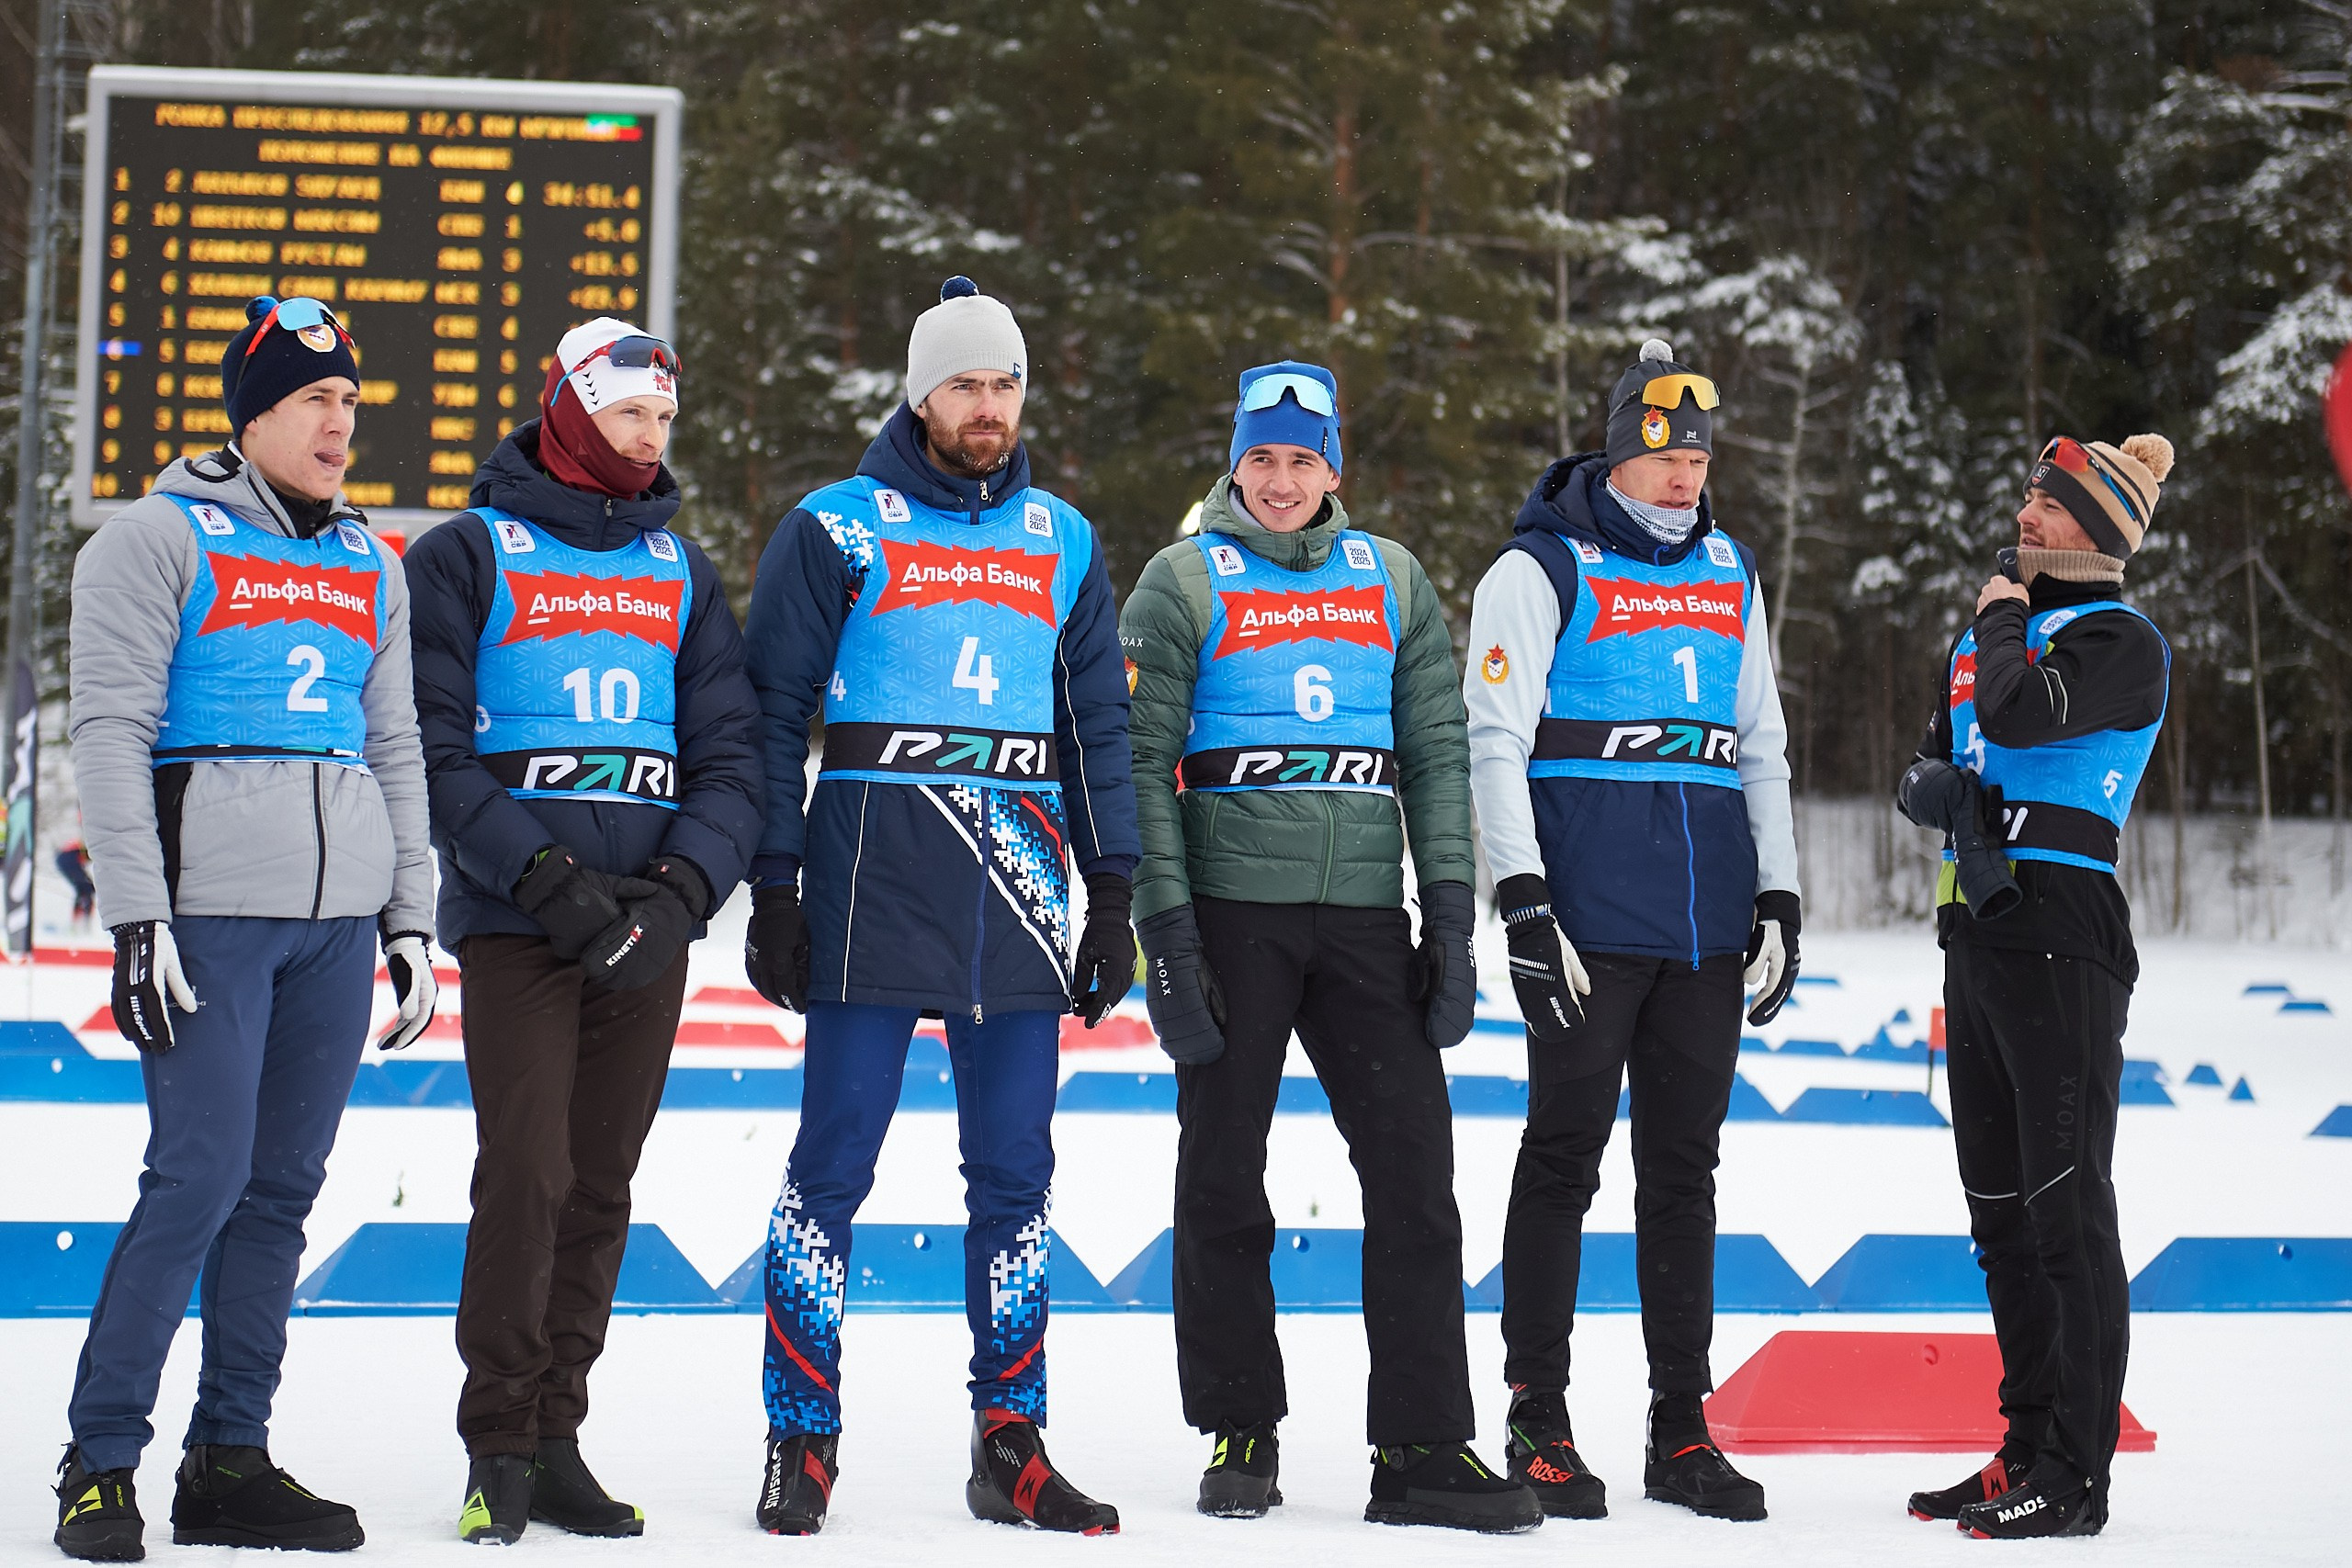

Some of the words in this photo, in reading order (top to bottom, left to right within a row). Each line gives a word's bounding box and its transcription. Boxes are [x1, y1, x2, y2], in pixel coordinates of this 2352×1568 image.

[1029, 512, 1046, 524] 2024
[1029, 520, 1047, 533] 2025
[653, 545, 673, 557] 2025
[1349, 547, 1368, 557] 2024
[1351, 556, 1371, 566] 2025
[902, 561, 983, 588] Альфа
[987, 562, 1043, 595] Банк
[231, 577, 315, 605] Альфа
[316, 580, 368, 615] Банк
[528, 590, 613, 617] Альфа
[616, 592, 673, 622] Банк
[1611, 594, 1684, 616] Альфа
[1685, 595, 1738, 617] Банк
[1239, 604, 1320, 628] Альфа
[1321, 603, 1378, 625] Банк
[1118, 637, 1144, 648] OAX
[286, 644, 328, 713] 2
[831, 671, 847, 702] 4
[952, 636, 1000, 705] 4
[1672, 646, 1699, 704] 1
[1952, 669, 1975, 688] Аль
[562, 667, 640, 725] 10
[1294, 663, 1335, 723] 6
[877, 730, 1047, 775] PARI
[1963, 722, 1986, 776] 5
[522, 754, 675, 797] PARI
[1228, 750, 1384, 785] PARI
[2102, 769, 2123, 799] 5
[1156, 957, 1171, 996] MOAX
[2055, 1075, 2077, 1149] MOAX
